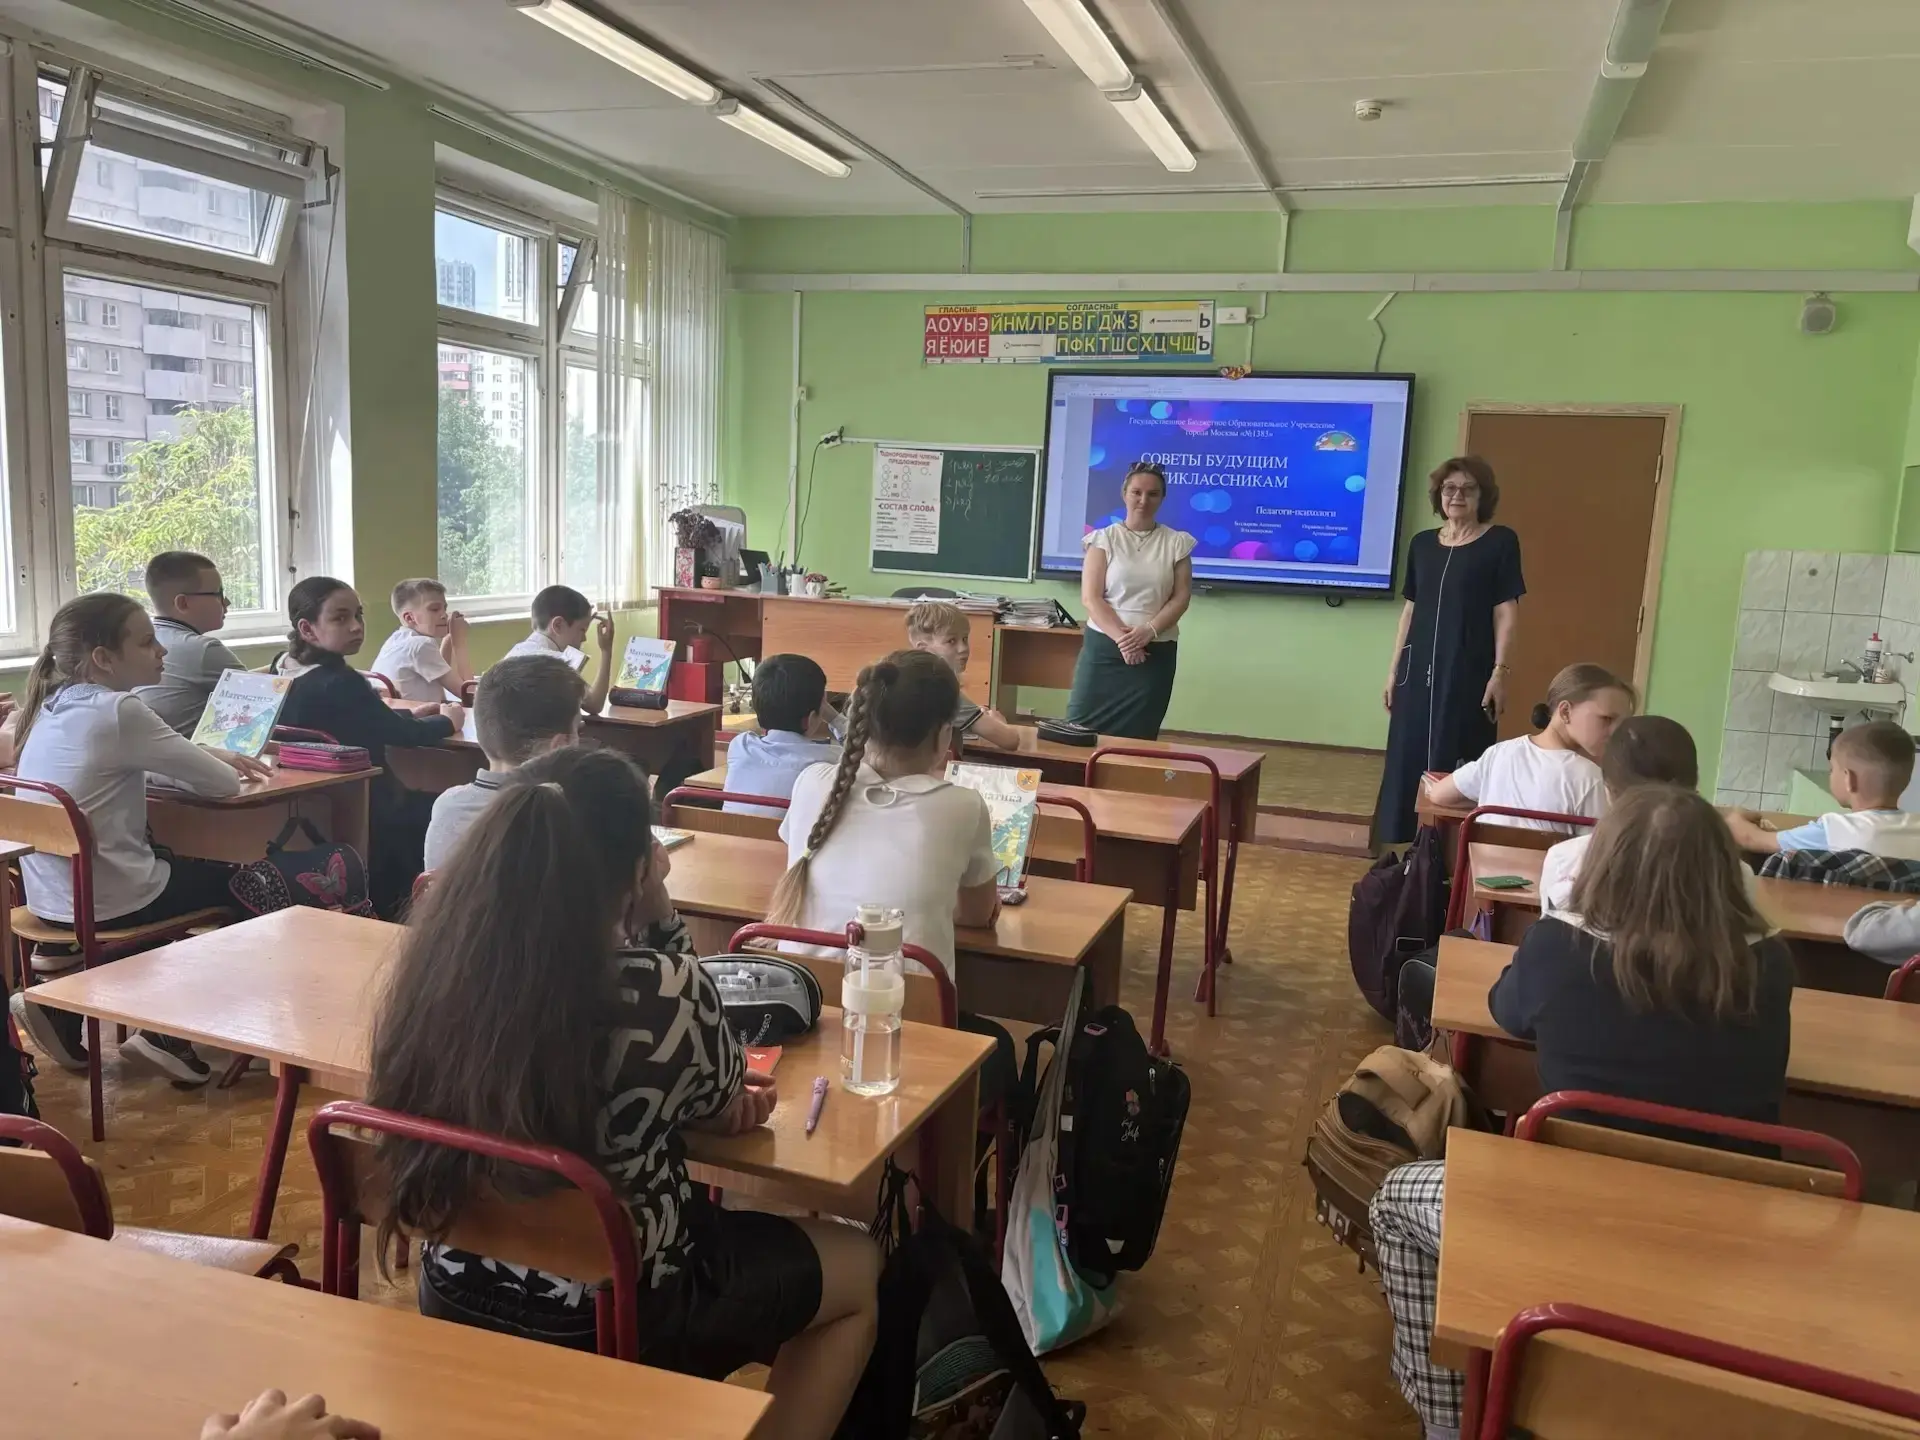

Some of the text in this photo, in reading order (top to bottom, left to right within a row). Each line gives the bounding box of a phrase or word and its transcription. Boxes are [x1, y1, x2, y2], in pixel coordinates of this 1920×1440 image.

[1066, 303, 1119, 311] СОГЛАСНЫЕ
[1210, 429, 1238, 437] Москвы
[1140, 452, 1288, 470] СОВЕТЫ БУДУЩИМ
[1161, 472, 1289, 489] ИКЛАССНИКАМ
[880, 503, 935, 512] СОСТАВ СЛОВА
